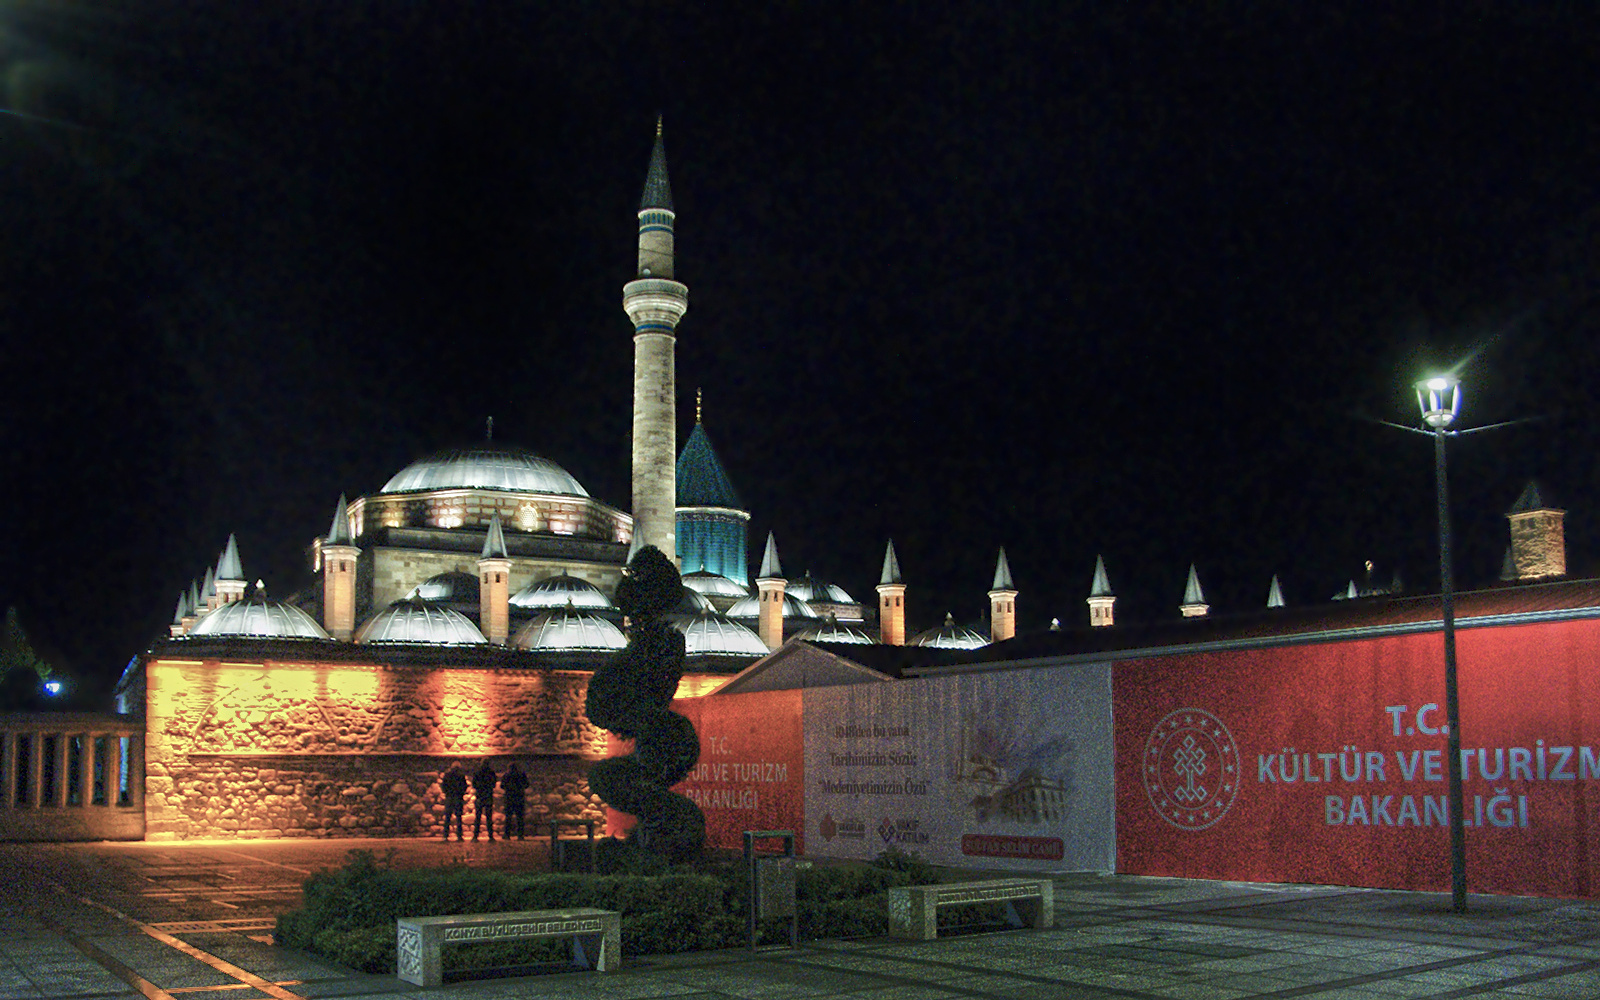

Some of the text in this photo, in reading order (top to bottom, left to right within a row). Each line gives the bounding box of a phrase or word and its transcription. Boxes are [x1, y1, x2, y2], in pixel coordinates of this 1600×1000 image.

[1385, 703, 1450, 736] T.C.
[873, 723, 885, 738] bu
[709, 736, 732, 755] T.C.
[829, 751, 886, 767] Tarihimizin
[1257, 738, 1600, 783] KÜLTÜR VE TURİZM
[712, 763, 728, 781] VE
[733, 759, 787, 782] TURİZM
[445, 927, 480, 940] KONYA
